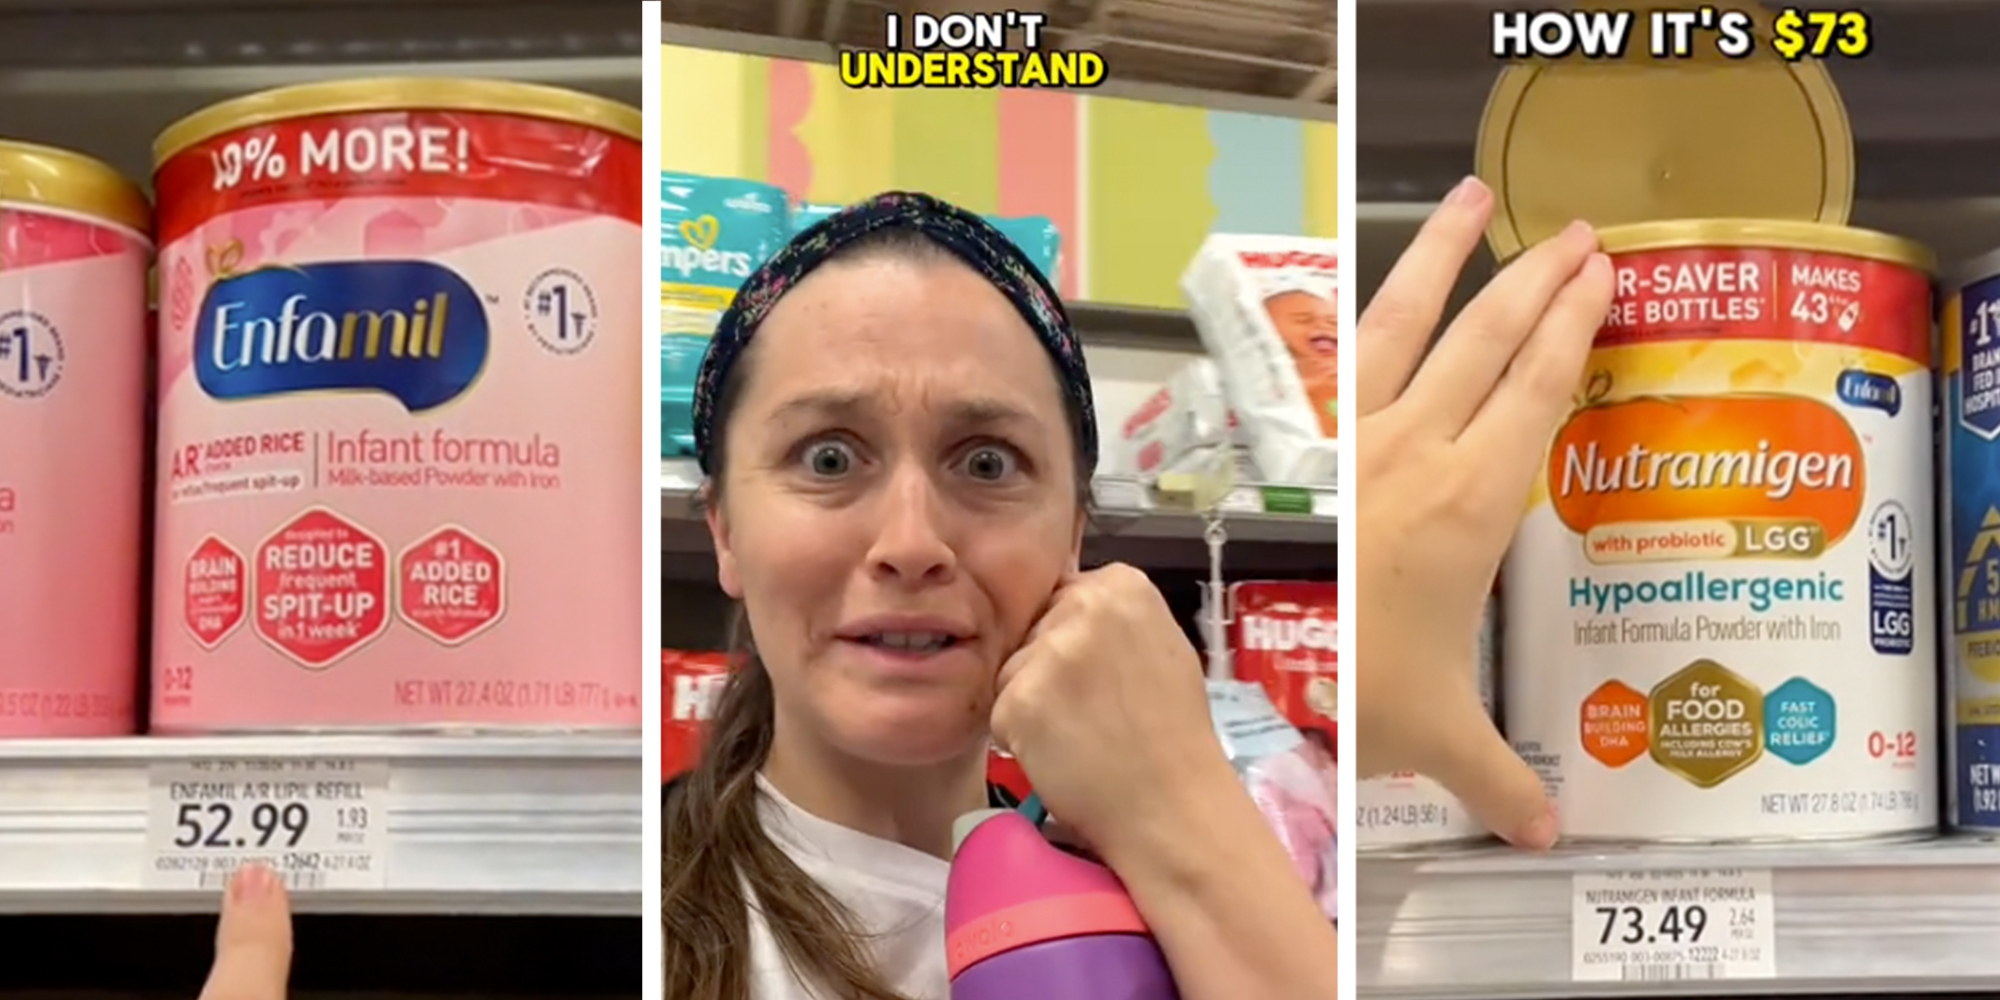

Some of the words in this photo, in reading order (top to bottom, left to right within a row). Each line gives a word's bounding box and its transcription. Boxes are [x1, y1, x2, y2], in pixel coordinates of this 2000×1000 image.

[302, 126, 468, 176] MORE!
[1791, 264, 1861, 292] MAKES
[538, 284, 567, 339] #1
[1791, 292, 1829, 324] 43
[212, 292, 447, 371] Enfamil
[205, 436, 257, 459] ADDED
[261, 432, 304, 454] RICE
[328, 429, 423, 463] Infant
[433, 429, 560, 468] formula
[328, 468, 421, 487] Milk-based
[425, 467, 490, 487] Powder
[494, 470, 527, 488] with
[531, 471, 560, 489] Iron
[1560, 438, 1852, 499] Nutramigen
[1592, 535, 1632, 553] with
[1636, 531, 1726, 555] probiotic
[1745, 526, 1812, 551] LGG
[190, 557, 237, 579] BRAIN
[266, 543, 373, 570] REDUCE
[279, 572, 356, 593] frequent
[410, 561, 493, 582] ADDED
[424, 583, 479, 606] RICE
[1570, 571, 1843, 614] Hypoallergenic
[264, 591, 374, 620] SPIT-UP
[1574, 619, 1618, 646] Infant
[1621, 614, 1692, 644] Formula
[1696, 614, 1761, 642] Powder
[1765, 616, 1807, 641] with
[1810, 615, 1841, 641] Iron
[1874, 610, 1911, 636] LGG
[395, 680, 425, 705] NET
[428, 680, 452, 706] WT
[1690, 682, 1721, 698] for
[1587, 704, 1641, 720] BRAIN
[1667, 700, 1744, 720] FOOD
[1780, 702, 1815, 714] FAST
[1584, 721, 1646, 735] BUILDING
[1660, 722, 1752, 738] ALLERGIES
[1777, 717, 1818, 730] COLIC
[1600, 735, 1629, 748] DHA
[1660, 738, 1716, 750] INCLUDING
[1868, 731, 1916, 758] 0-12
[170, 782, 236, 800] ENFAMIL
[274, 782, 309, 800] LIPIL
[315, 781, 364, 800] REFILL
[1761, 793, 1787, 814] NET
[1789, 792, 1809, 814] WT
[174, 803, 309, 848] 52.99
[337, 807, 368, 829] 1.93
[1368, 804, 1399, 830] (1.24
[1586, 890, 1658, 904] NUTRAMIGEN
[1662, 889, 1699, 903] INFANT
[1704, 887, 1755, 902] FORMULA
[1596, 905, 1707, 944] 73.49
[1729, 908, 1755, 926] 2.64
